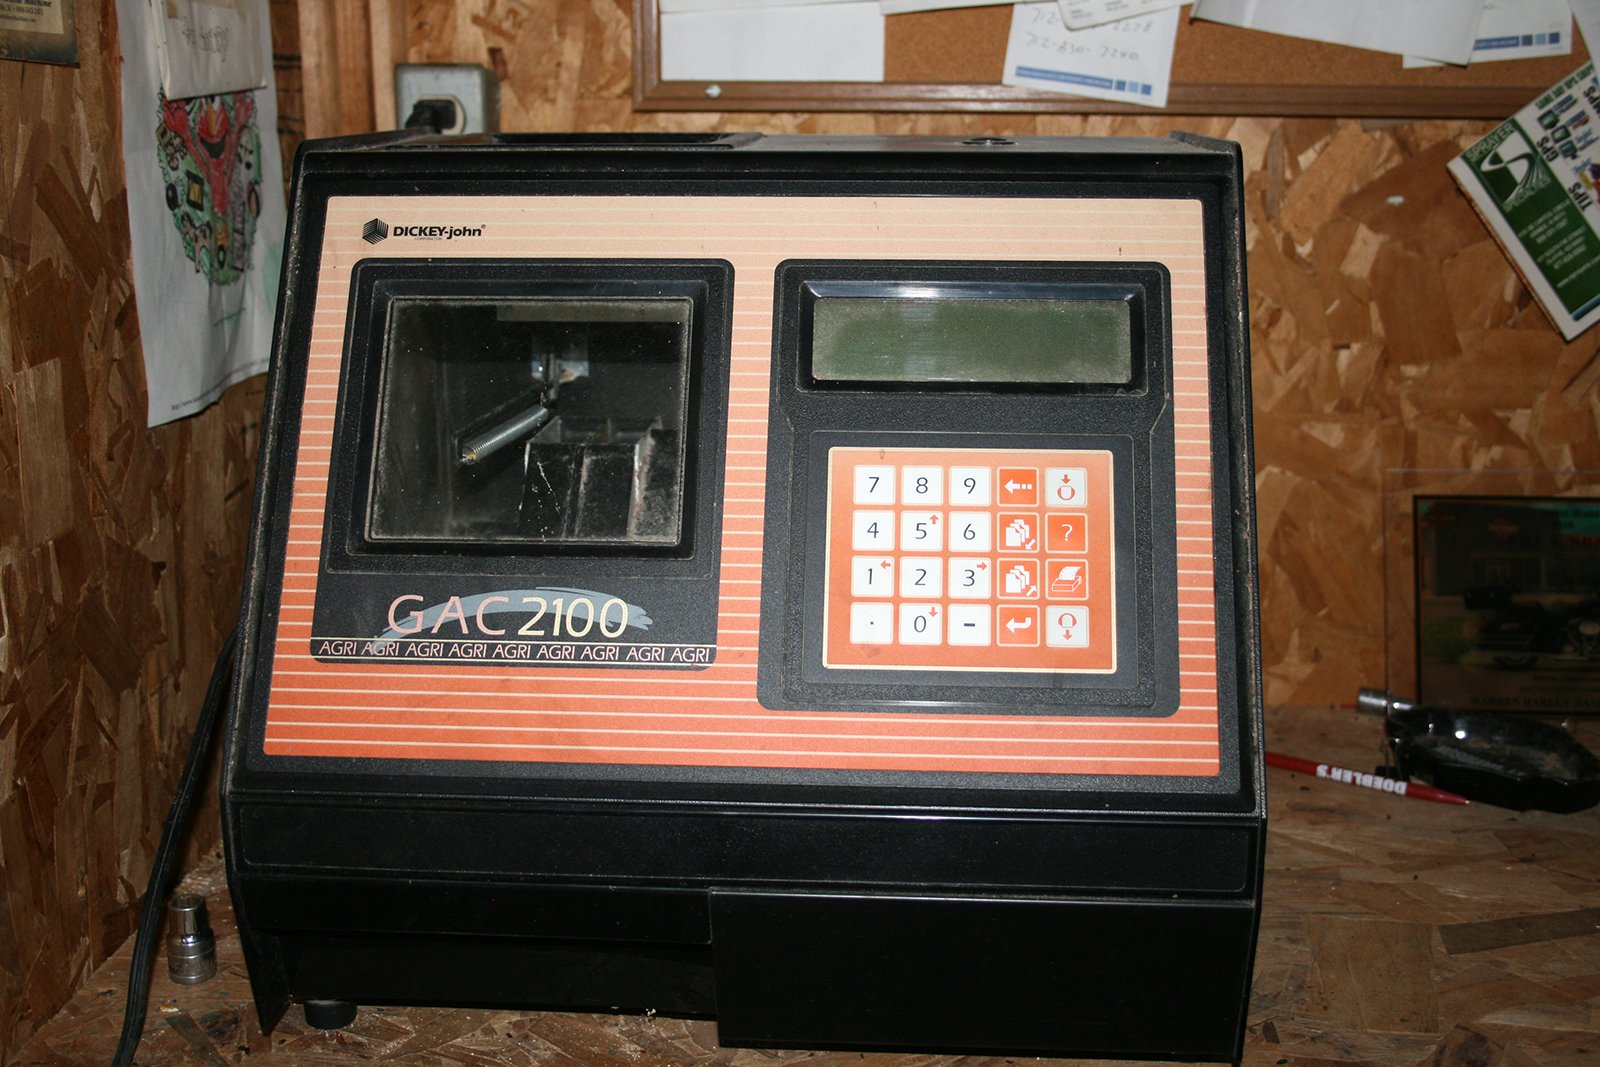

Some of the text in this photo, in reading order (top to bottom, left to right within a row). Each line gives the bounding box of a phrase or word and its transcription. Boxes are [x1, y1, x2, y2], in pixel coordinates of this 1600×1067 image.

[1465, 121, 1517, 164] SPRAYER
[1536, 136, 1559, 163] GPS
[1568, 181, 1593, 212] TIPS
[868, 476, 880, 493] 7
[915, 477, 929, 494] 8
[963, 477, 976, 494] 9
[867, 522, 879, 539] 4
[915, 522, 927, 539] 5
[963, 523, 976, 541] 6
[867, 568, 873, 585] 1
[914, 568, 927, 586] 2
[963, 569, 975, 587] 3
[387, 595, 629, 637] GAC 2100
[914, 616, 927, 633] 0
[318, 640, 710, 663] AGRI AGRI AGRI AGRI AGRI AGRI AGRI AGRI AGRI
[1315, 763, 1408, 796] DOEBLER'S
